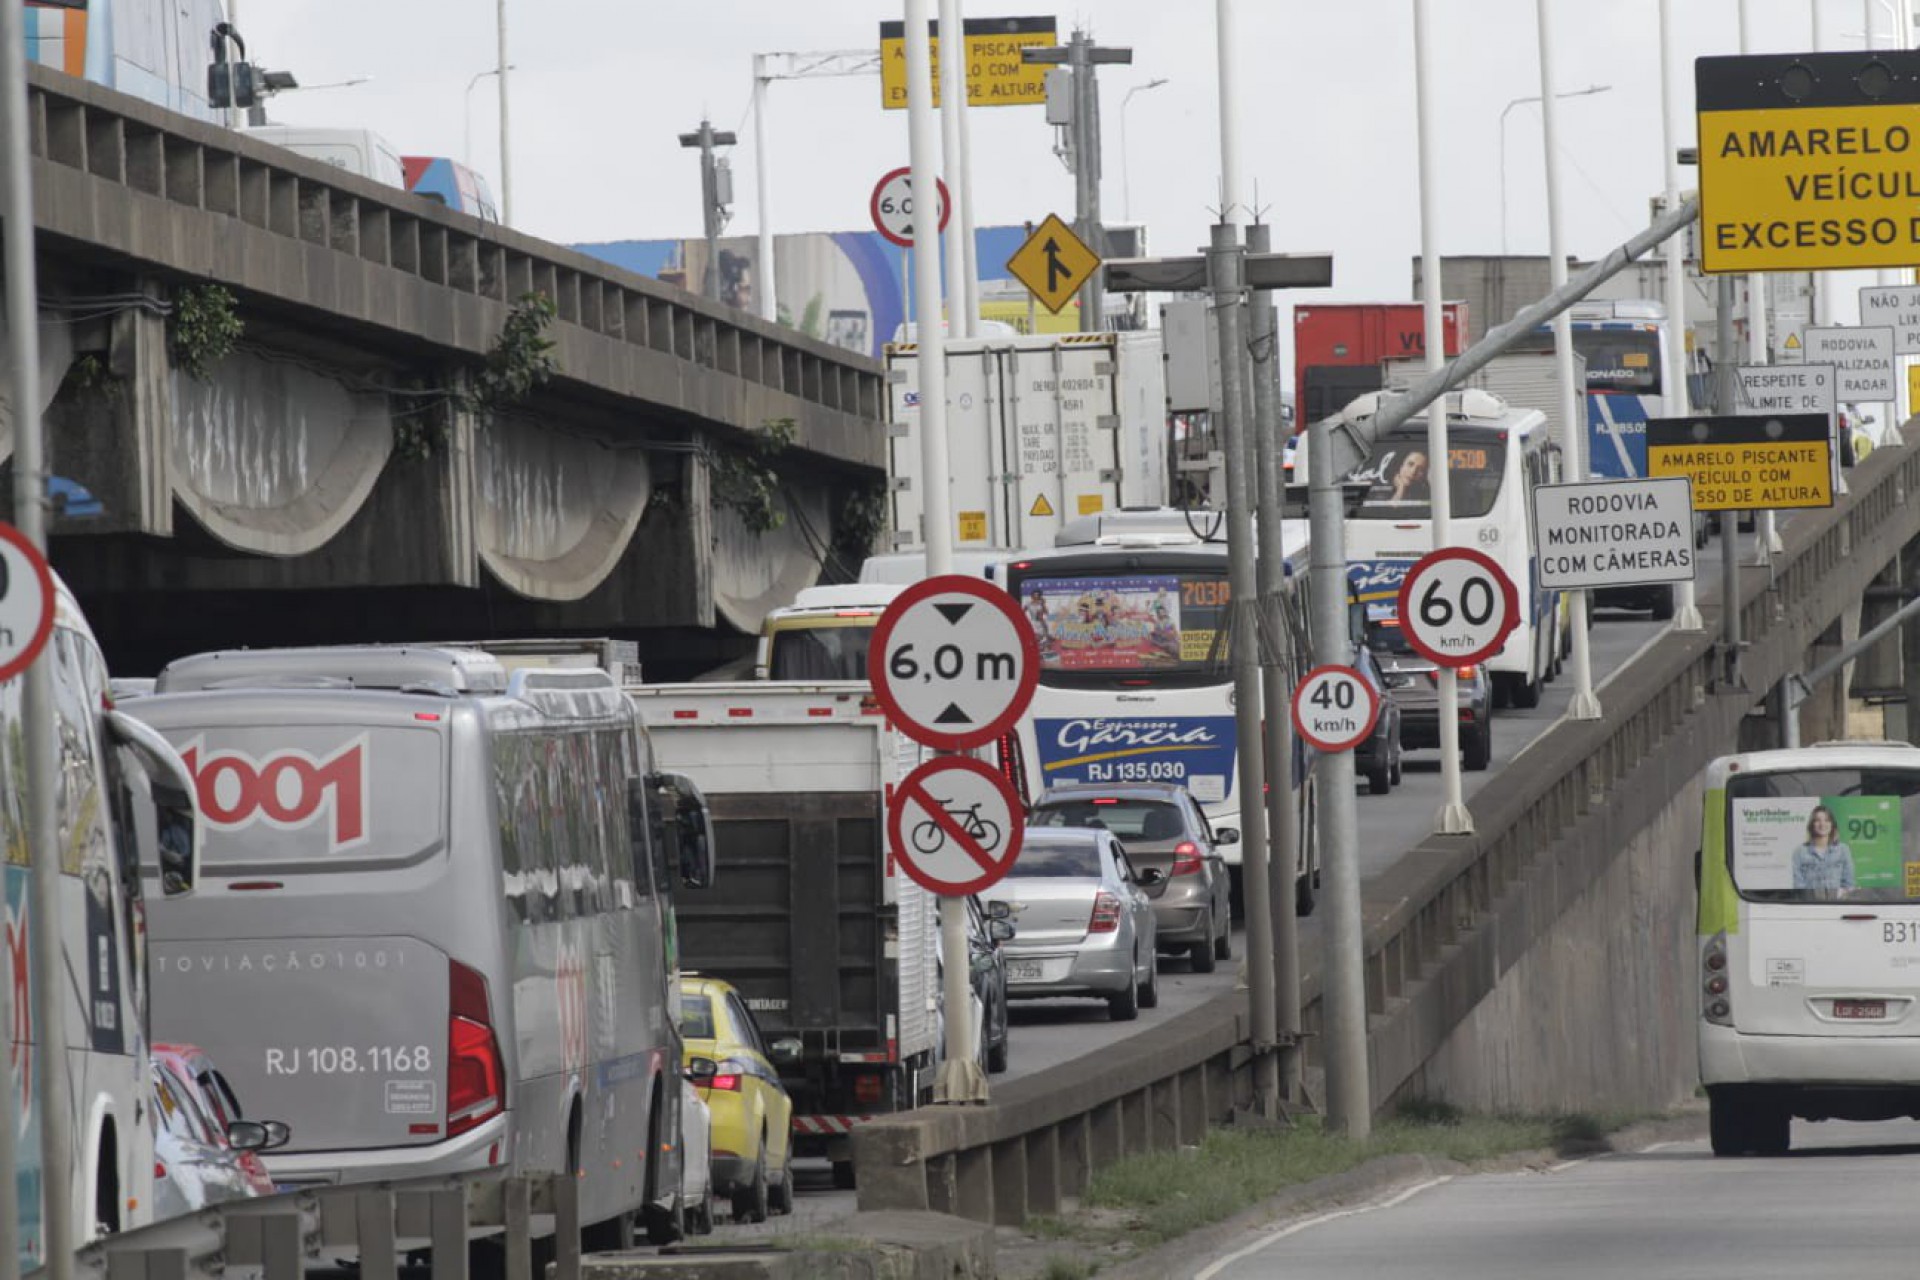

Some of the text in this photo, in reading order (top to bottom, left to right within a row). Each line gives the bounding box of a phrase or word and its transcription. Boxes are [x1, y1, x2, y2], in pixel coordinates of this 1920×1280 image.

[989, 63, 1019, 76] COM
[991, 83, 1046, 96] ALTURA
[1720, 125, 1910, 158] AMARELO
[1785, 166, 1920, 201] VEÍCUL
[1716, 217, 1897, 250] EXCESSO
[1870, 294, 1899, 308] NÃO
[1821, 338, 1877, 350] RODOVIA
[1744, 374, 1825, 388] RESPEITE O
[1845, 379, 1887, 391] RADAR
[1750, 395, 1818, 410] LIMITE DE
[1662, 450, 1816, 467] AMARELO PISCANTE
[1759, 469, 1790, 482] COM
[1734, 489, 1753, 502] DE
[1762, 486, 1821, 501] ALTURA
[1568, 493, 1658, 515] RODOVIA
[1548, 521, 1681, 546] MONITORADA
[1543, 548, 1690, 574] COM CÂMERAS
[1182, 581, 1231, 606] 7030
[1420, 577, 1494, 627] 60
[1440, 633, 1475, 648] km/h
[890, 643, 1015, 683] 6,0 m
[1311, 680, 1354, 710] 40
[1313, 717, 1356, 732] km/h
[1089, 762, 1185, 780] RJ 135.030
[1883, 922, 1920, 943] B31
[266, 1045, 431, 1075] RJ 108.1168
